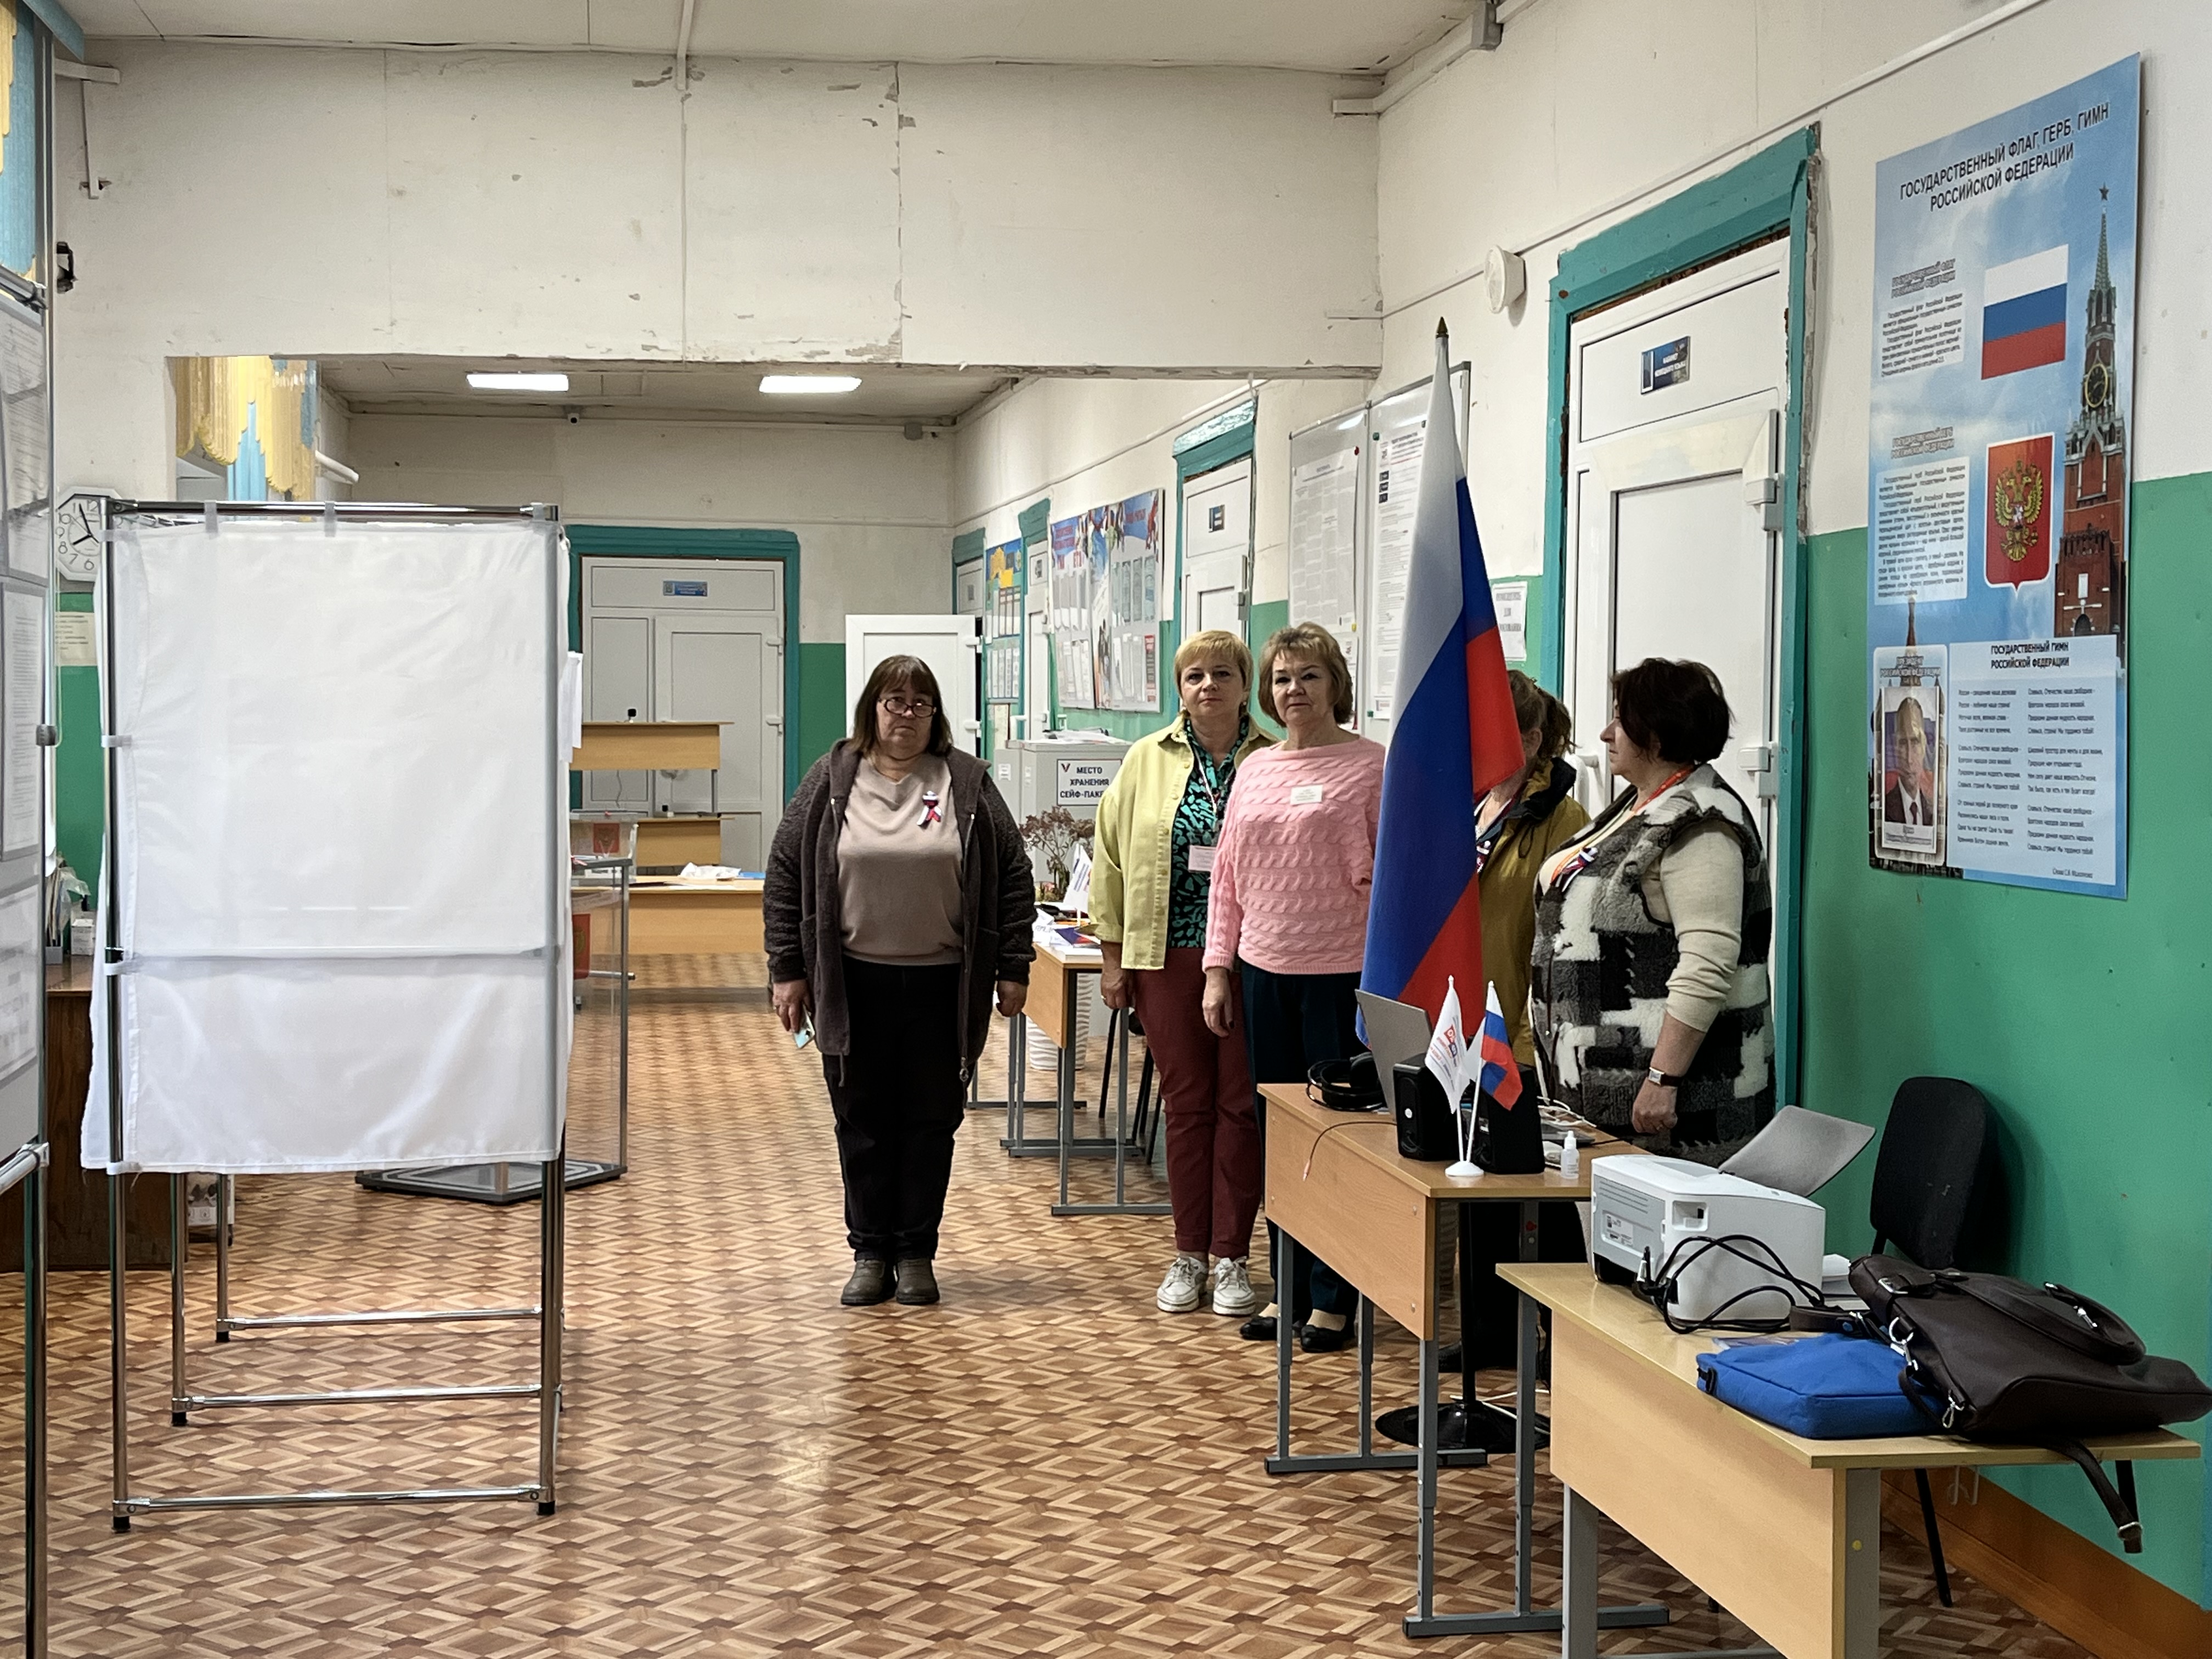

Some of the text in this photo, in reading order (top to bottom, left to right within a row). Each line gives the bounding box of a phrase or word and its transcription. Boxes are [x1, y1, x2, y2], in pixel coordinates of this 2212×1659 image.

[1899, 143, 2006, 200] ГОСУДАРСТВЕННЫЙ
[2078, 101, 2109, 131] ГИМН
[1930, 142, 2074, 212] РОССИЙСКОЙ ФЕДЕРАЦИИ
[58, 541, 68, 554] 8
[69, 553, 78, 565] 7
[84, 559, 94, 571] 6
[1991, 640, 2050, 655] ГОСУДАРСТВЕННЫЙ
[1991, 656, 2069, 669] РОССИЙСКОЙ ФЕДЕРАЦИИ
[1060, 789, 1104, 798] СЕЙФ-ПАКЕ
